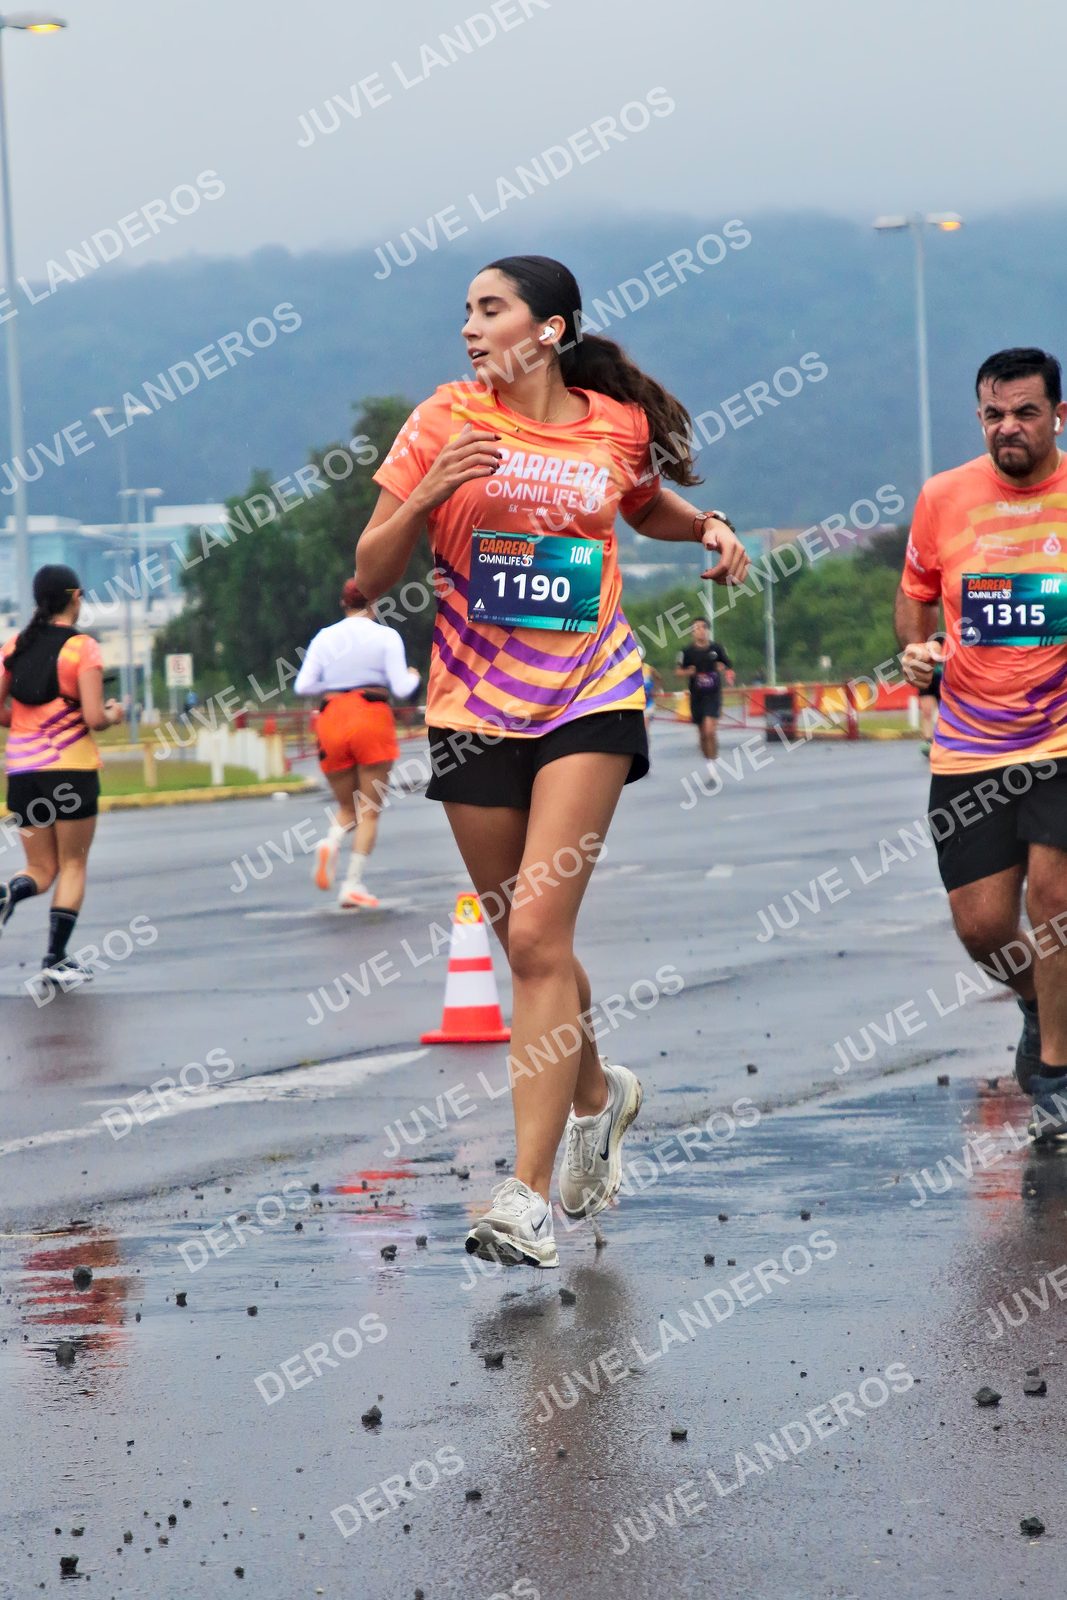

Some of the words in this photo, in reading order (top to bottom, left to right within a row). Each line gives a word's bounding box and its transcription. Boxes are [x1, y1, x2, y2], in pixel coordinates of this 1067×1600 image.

[492, 448, 610, 497] CARRERA
[479, 538, 536, 556] CARRERA
[569, 545, 594, 566] 10K
[492, 571, 571, 603] 1190
[967, 578, 1013, 591] CARRERA
[1040, 578, 1060, 594] 10K
[982, 603, 1046, 626] 1315
